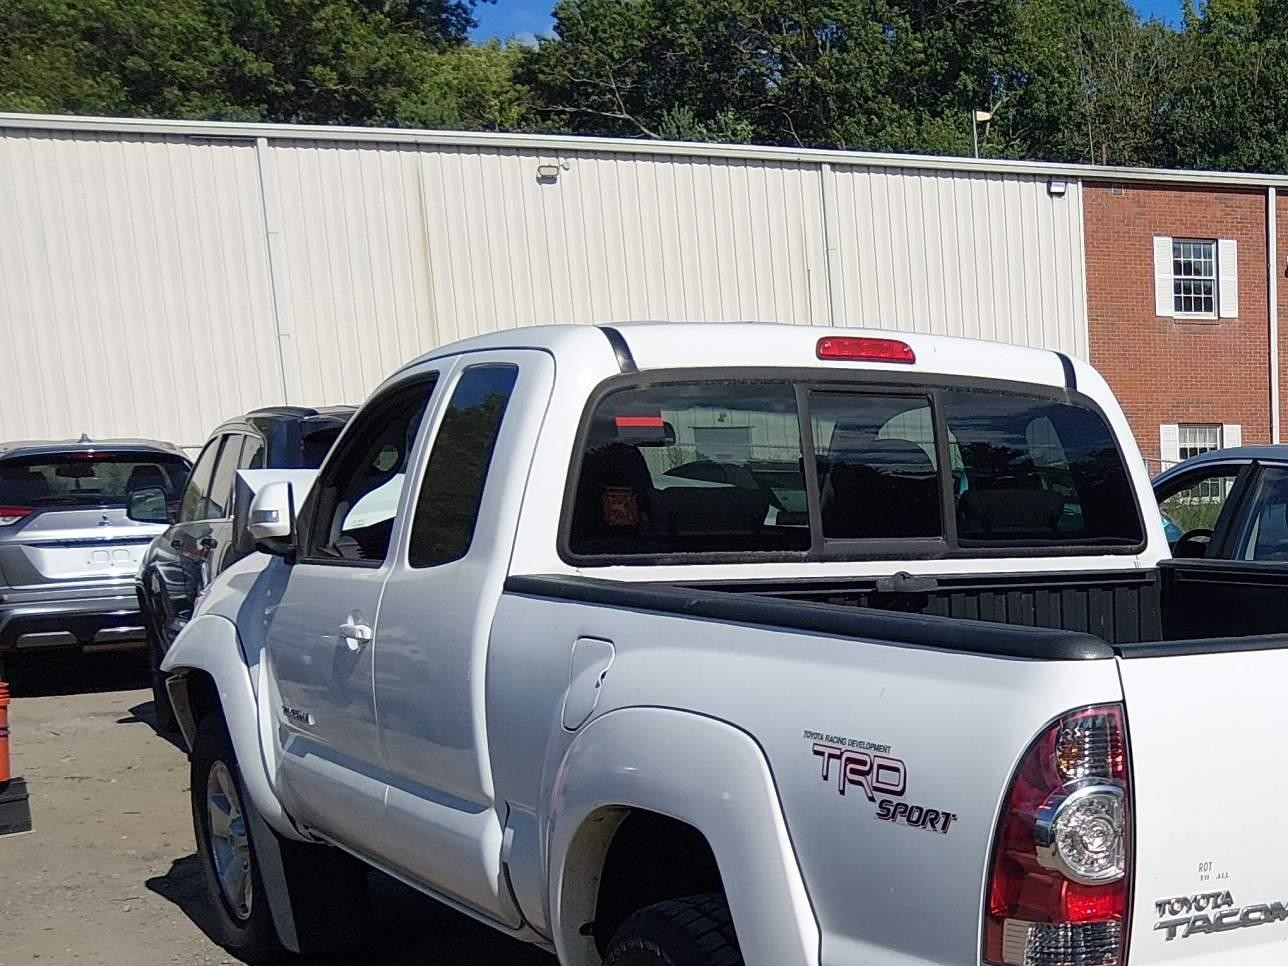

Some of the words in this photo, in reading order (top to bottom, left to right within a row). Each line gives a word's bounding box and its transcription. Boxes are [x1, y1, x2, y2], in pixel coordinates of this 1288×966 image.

[803, 730, 824, 741] TOYOTA
[825, 734, 847, 746] RACING
[848, 738, 891, 754] DEVELOPMENT
[812, 742, 908, 803] TRD
[874, 798, 957, 834] SPORT
[1155, 890, 1235, 917] TOYOTA
